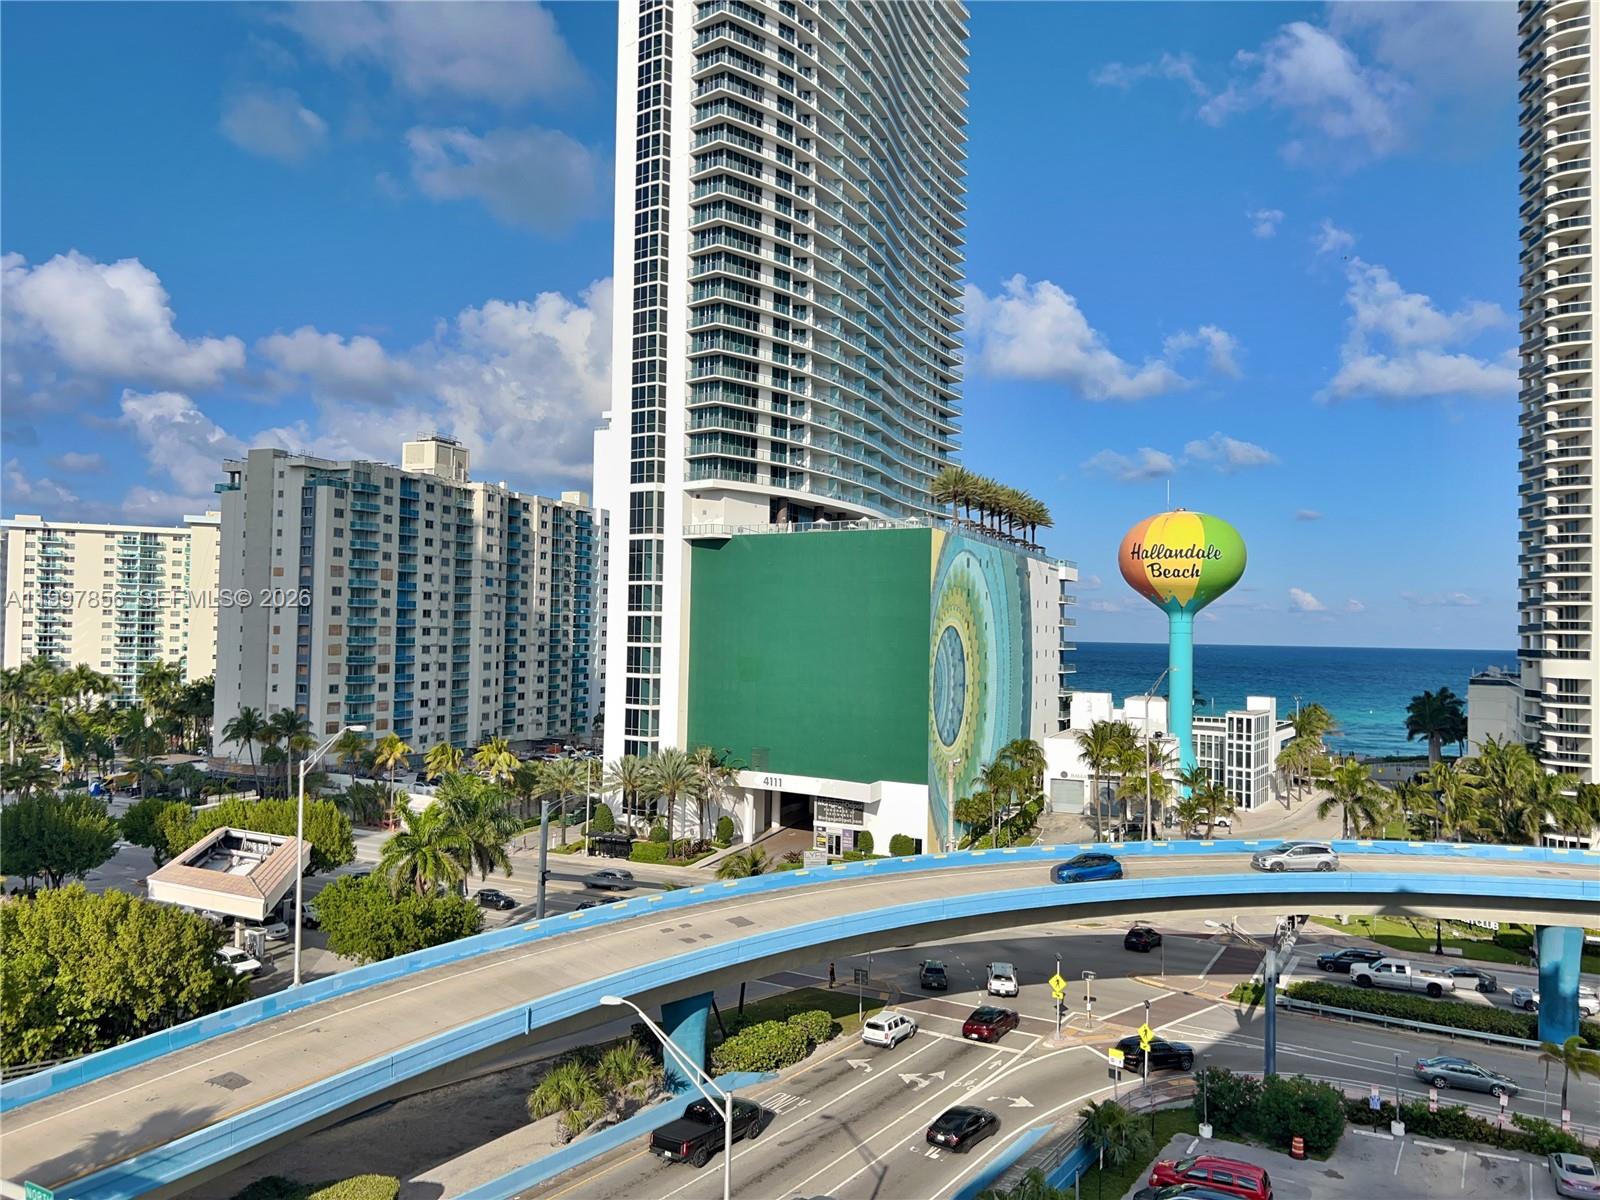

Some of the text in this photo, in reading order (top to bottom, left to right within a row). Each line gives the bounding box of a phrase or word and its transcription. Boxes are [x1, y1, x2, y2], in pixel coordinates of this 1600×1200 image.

[1131, 542, 1222, 560] Hallandale
[1147, 562, 1200, 578] Beach
[763, 776, 782, 787] 4111
[1475, 919, 1499, 930] CLUB
[760, 1093, 811, 1115] ONLY
